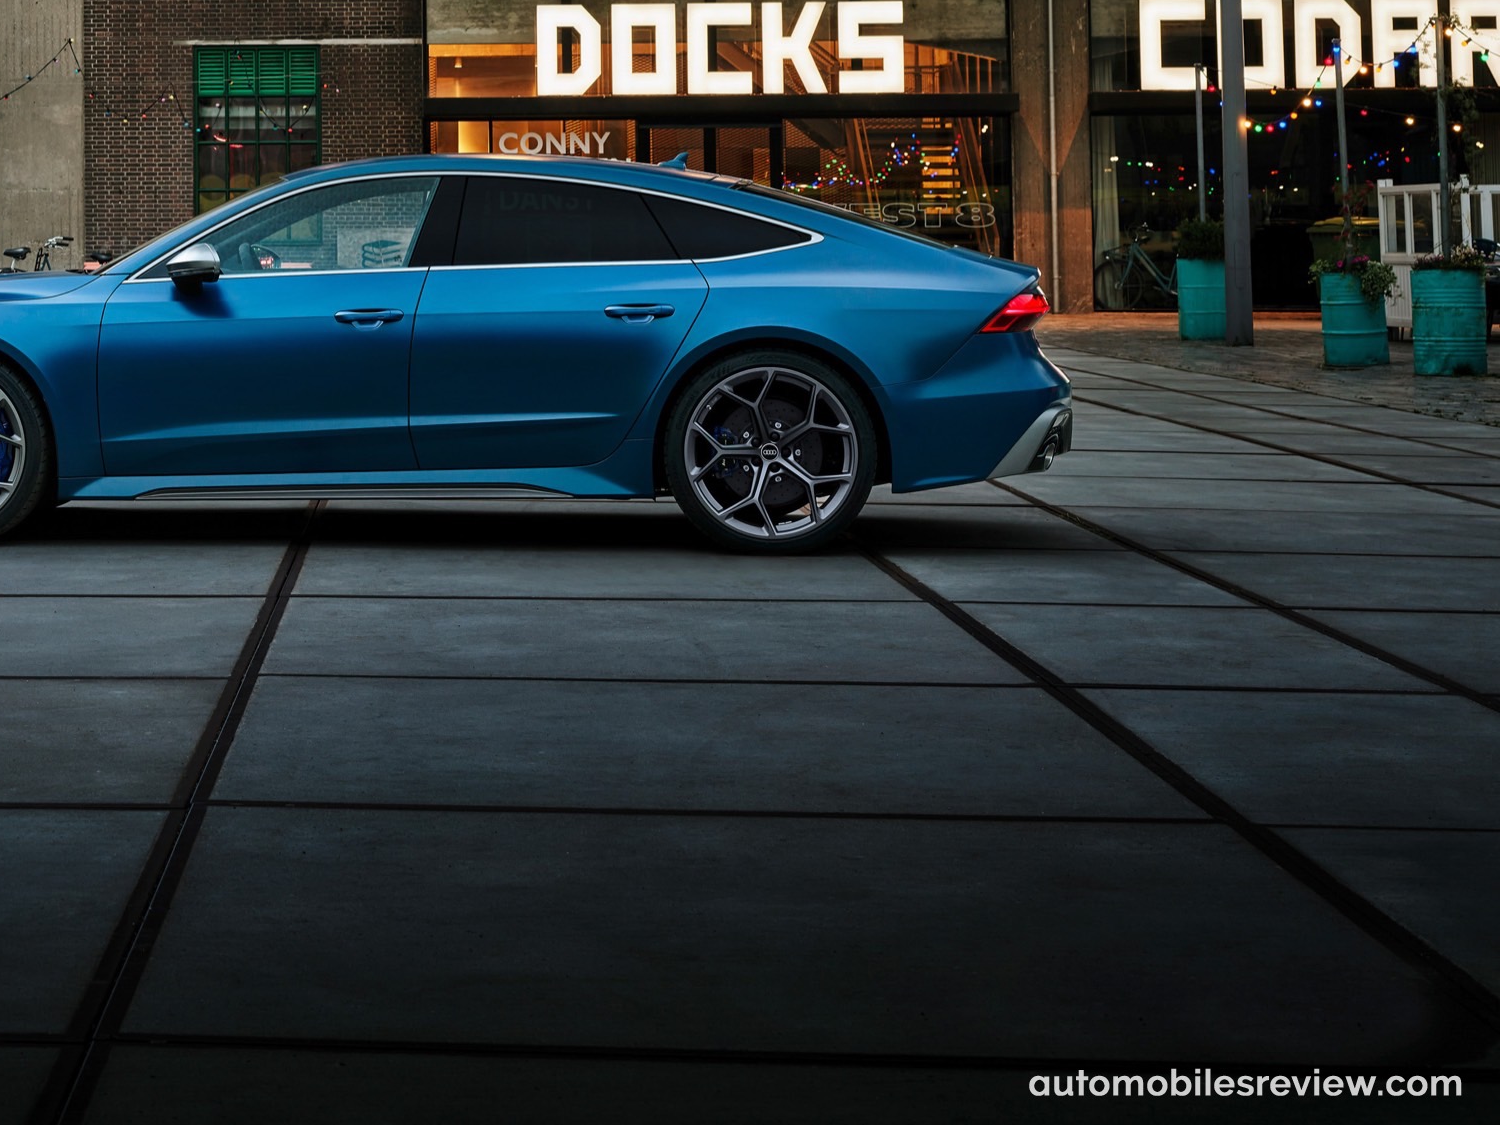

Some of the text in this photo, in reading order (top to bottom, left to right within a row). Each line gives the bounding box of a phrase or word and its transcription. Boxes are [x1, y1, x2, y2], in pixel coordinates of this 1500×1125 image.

[536, 1, 905, 96] DOCKS
[498, 132, 611, 155] CONNY
[833, 202, 996, 229] EST 8
